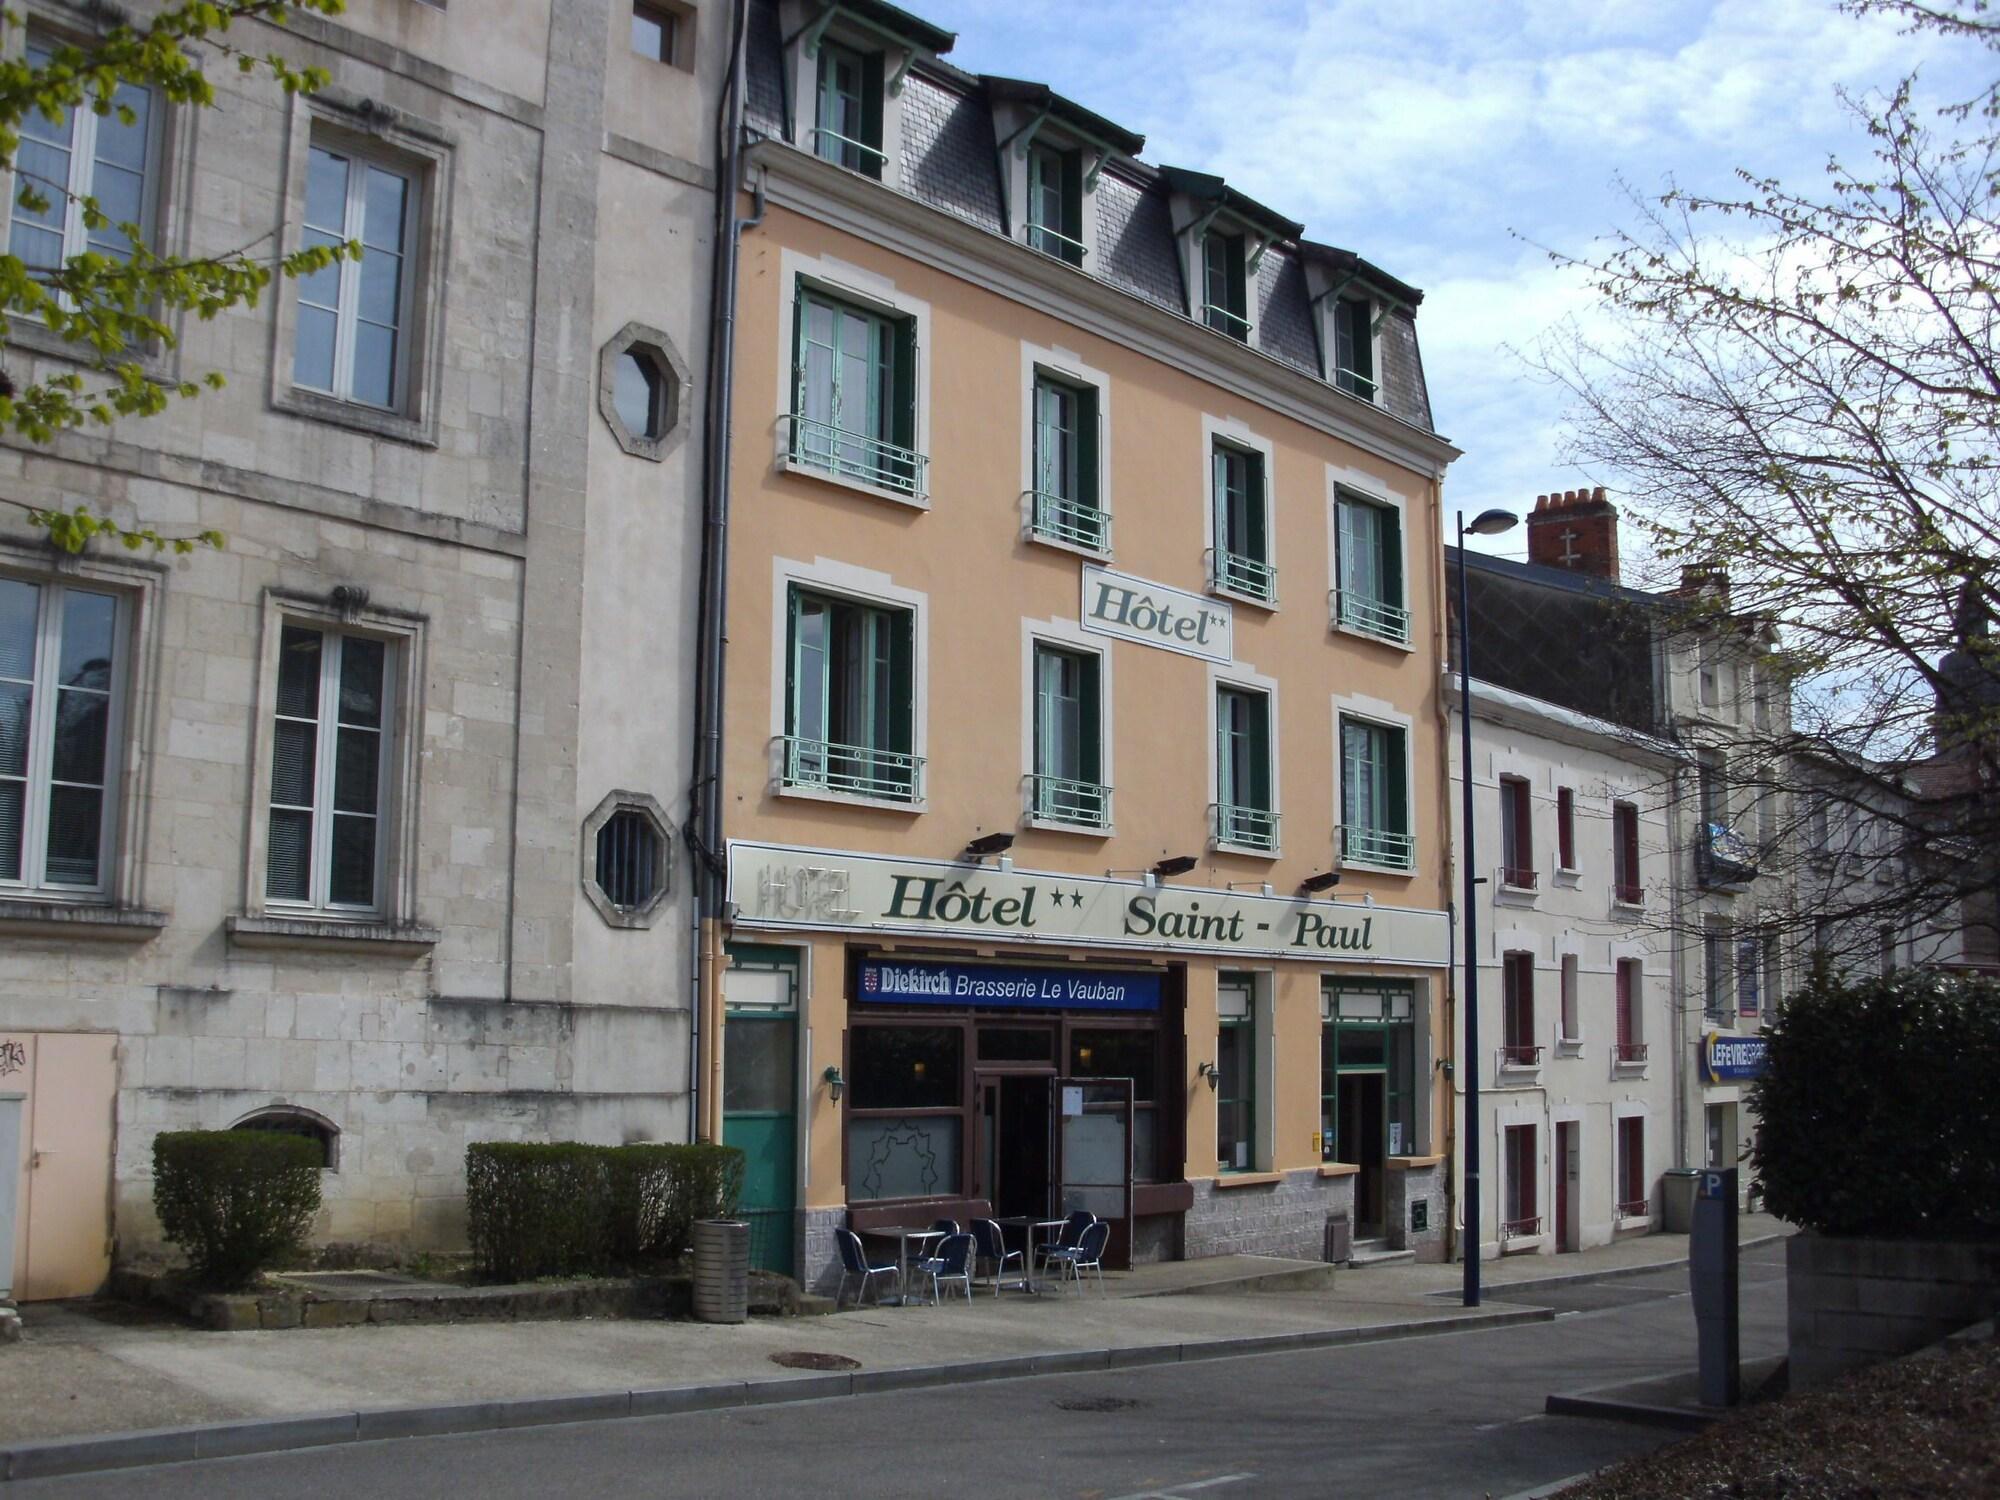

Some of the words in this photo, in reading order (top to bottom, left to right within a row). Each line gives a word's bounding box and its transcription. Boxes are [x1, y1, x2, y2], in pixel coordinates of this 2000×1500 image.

[1089, 582, 1210, 646] Hôtel
[881, 874, 1037, 928] Hôtel
[1124, 896, 1244, 942] Saint
[1290, 912, 1373, 951] Paul
[881, 967, 951, 996] Diekirch
[955, 975, 1036, 998] Brasserie
[1041, 982, 1061, 999] Le
[1067, 979, 1125, 1001] Vauban
[1707, 1174, 1721, 1196] P
